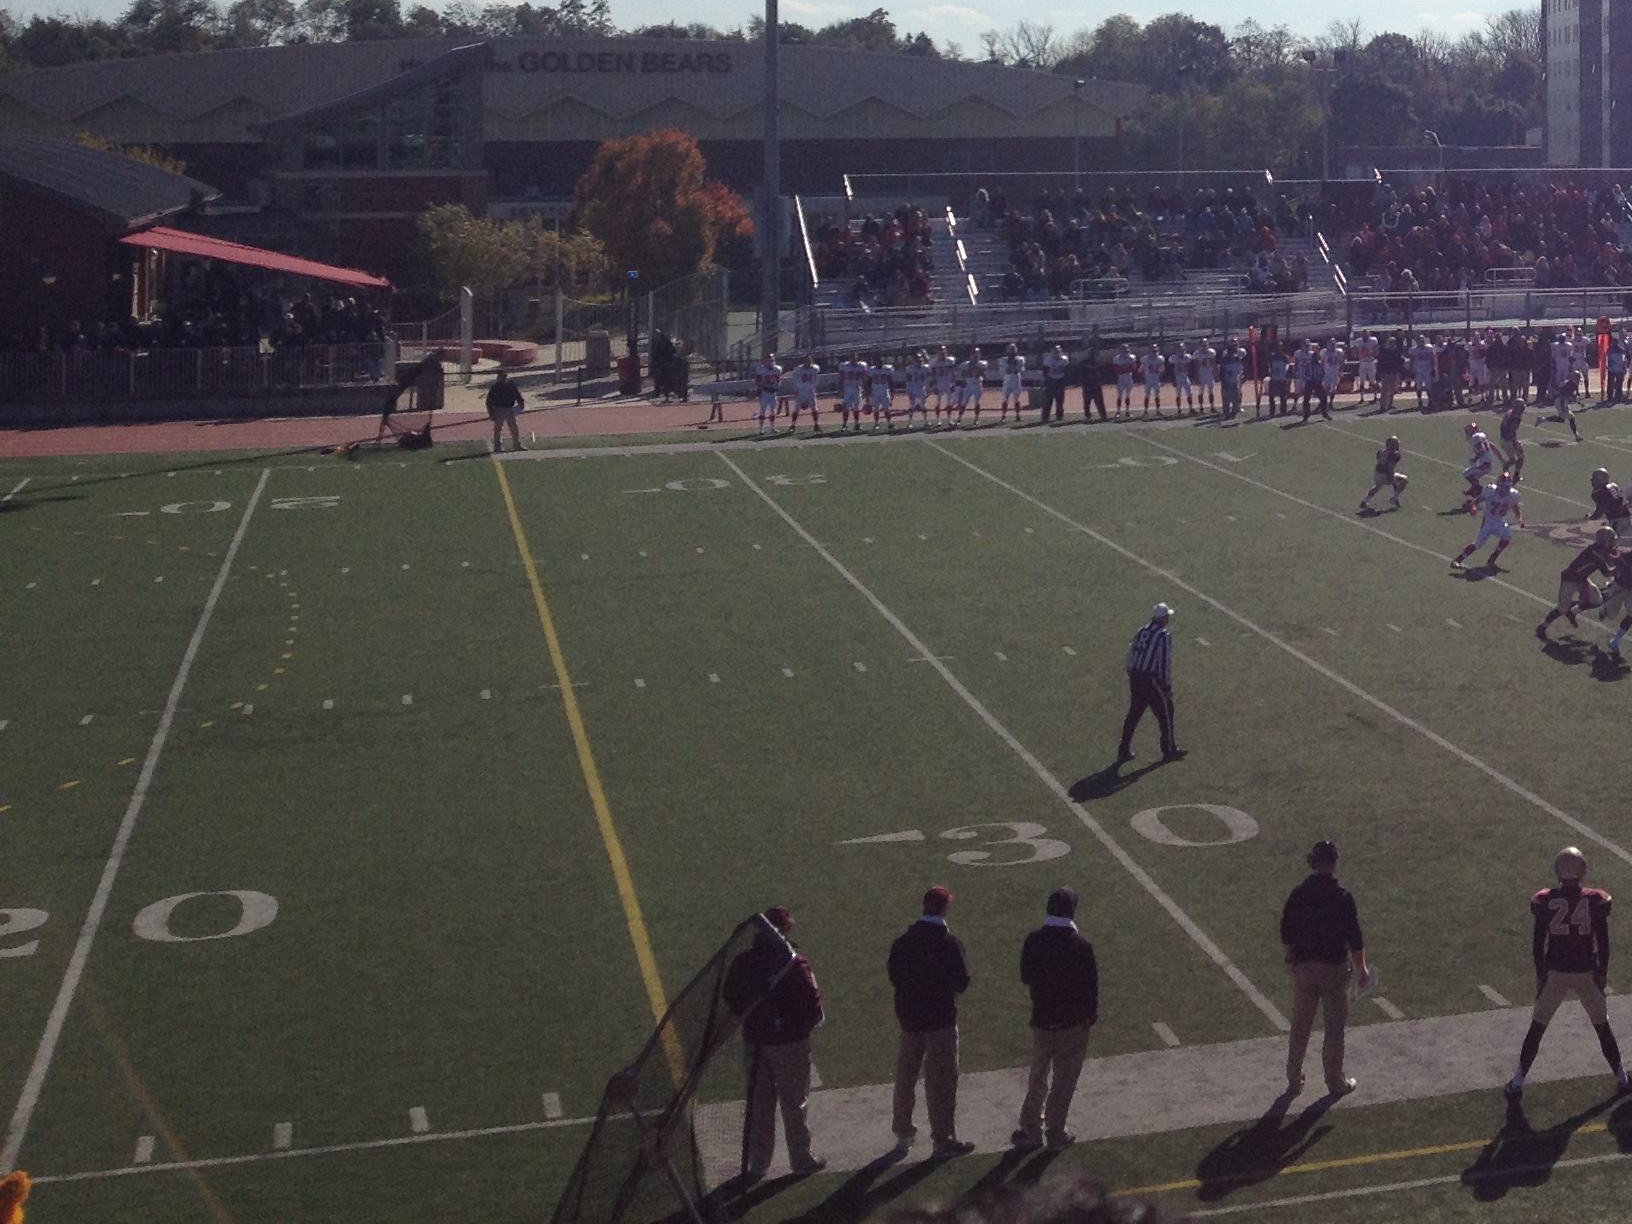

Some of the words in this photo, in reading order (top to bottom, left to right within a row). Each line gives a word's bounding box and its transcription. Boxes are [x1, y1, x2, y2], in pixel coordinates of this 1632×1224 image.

[518, 51, 636, 73] GOLDEN
[640, 51, 734, 73] BEARS
[1548, 898, 1592, 935] 24
